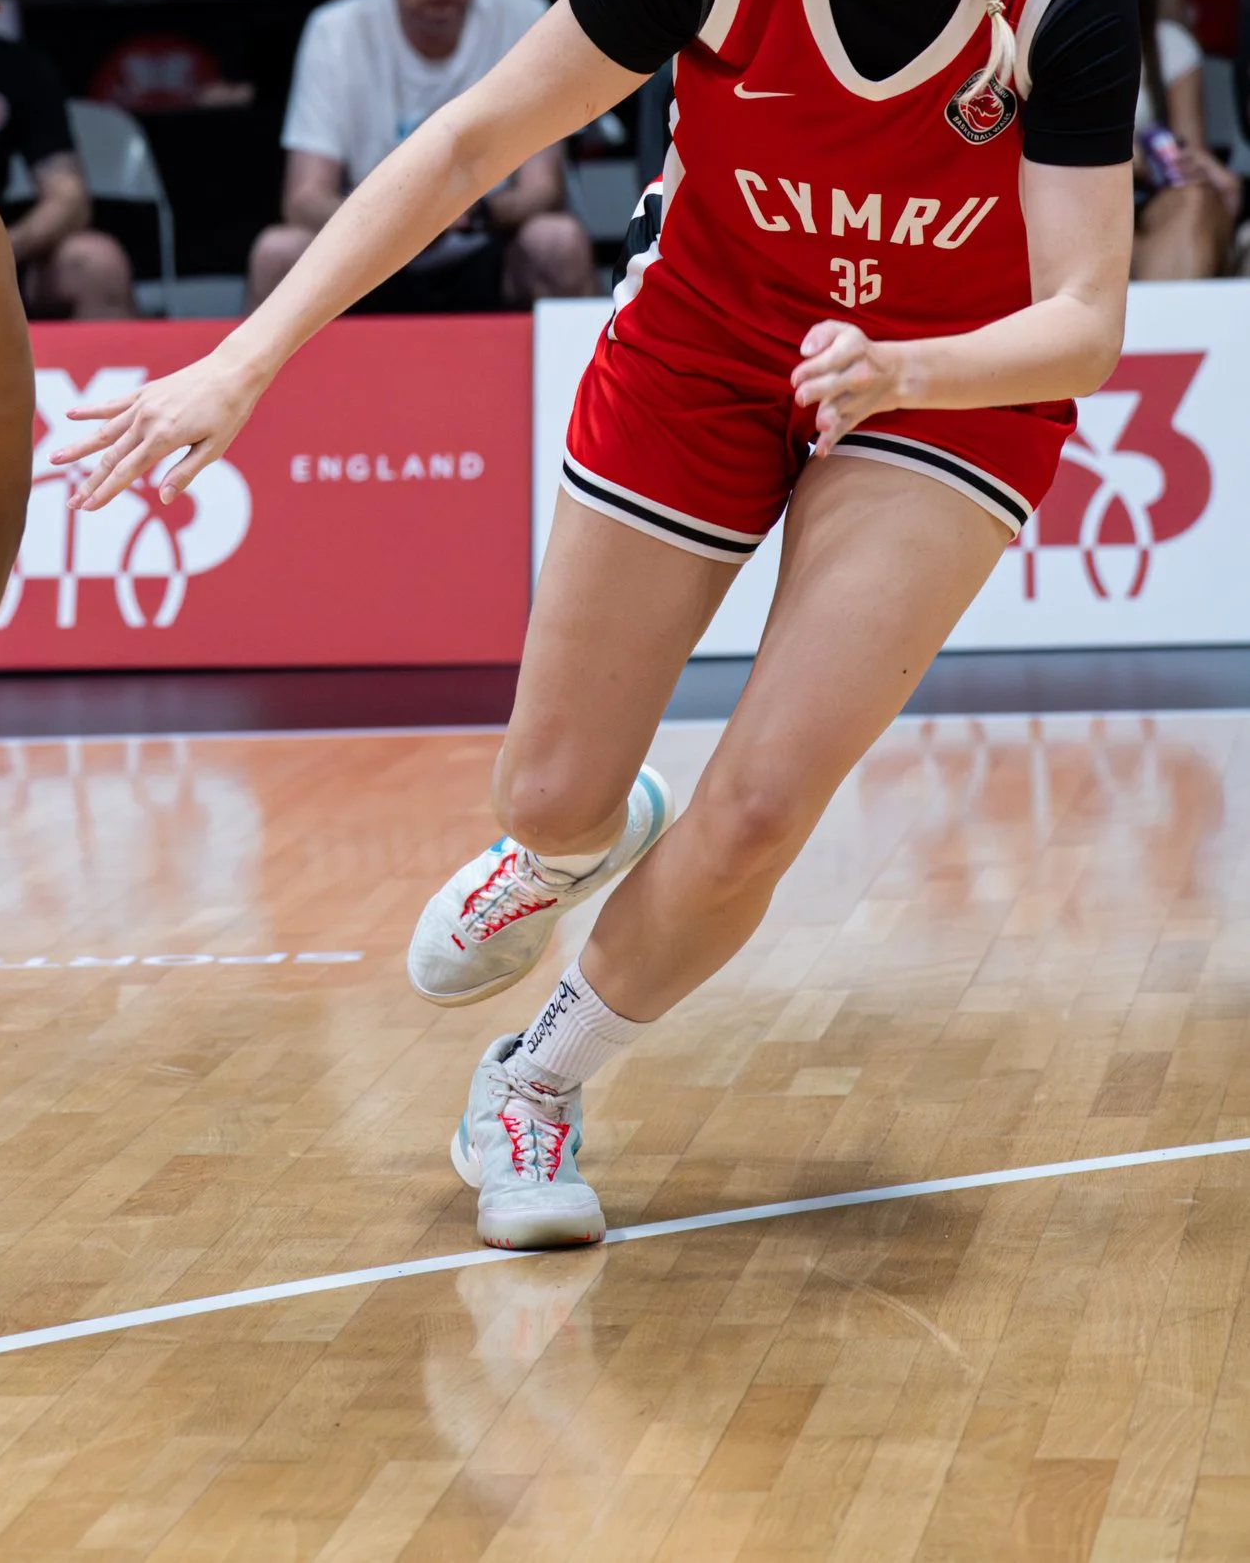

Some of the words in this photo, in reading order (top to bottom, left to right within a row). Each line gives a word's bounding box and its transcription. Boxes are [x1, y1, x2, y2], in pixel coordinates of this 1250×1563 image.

[952, 115, 993, 141] BASKETBALL
[992, 112, 1012, 133] WALES
[734, 168, 1000, 250] CYMRU
[829, 257, 882, 309] 35
[291, 451, 486, 484] ENGLAND
